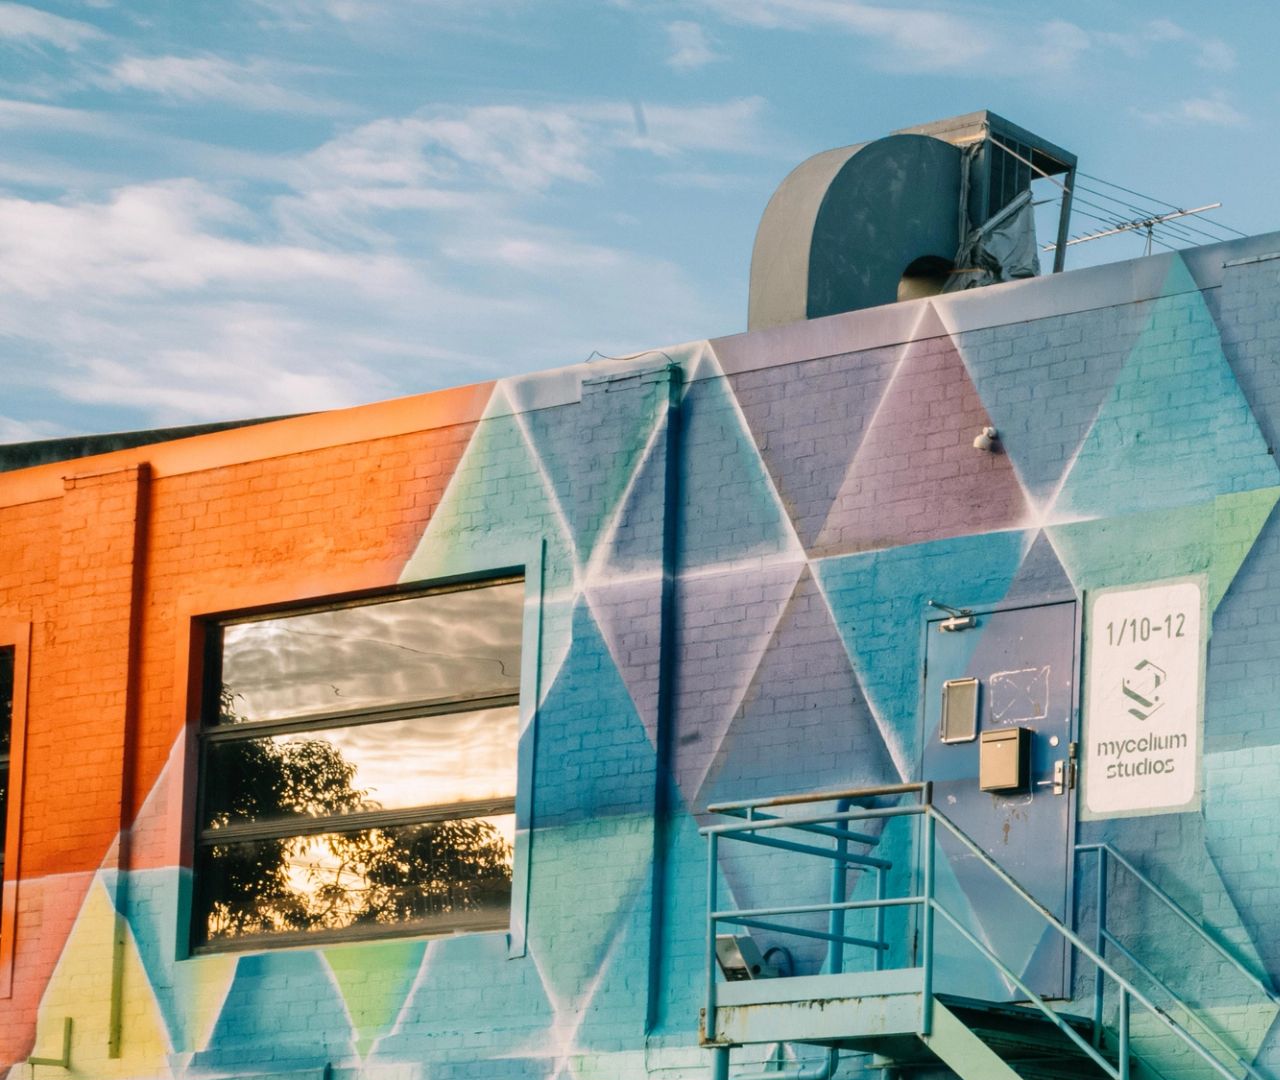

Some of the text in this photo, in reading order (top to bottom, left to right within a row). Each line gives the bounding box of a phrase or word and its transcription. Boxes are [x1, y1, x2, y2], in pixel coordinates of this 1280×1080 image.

[1106, 612, 1186, 647] 1/10-12
[1097, 731, 1188, 760] mycelium
[1106, 757, 1175, 779] studios
